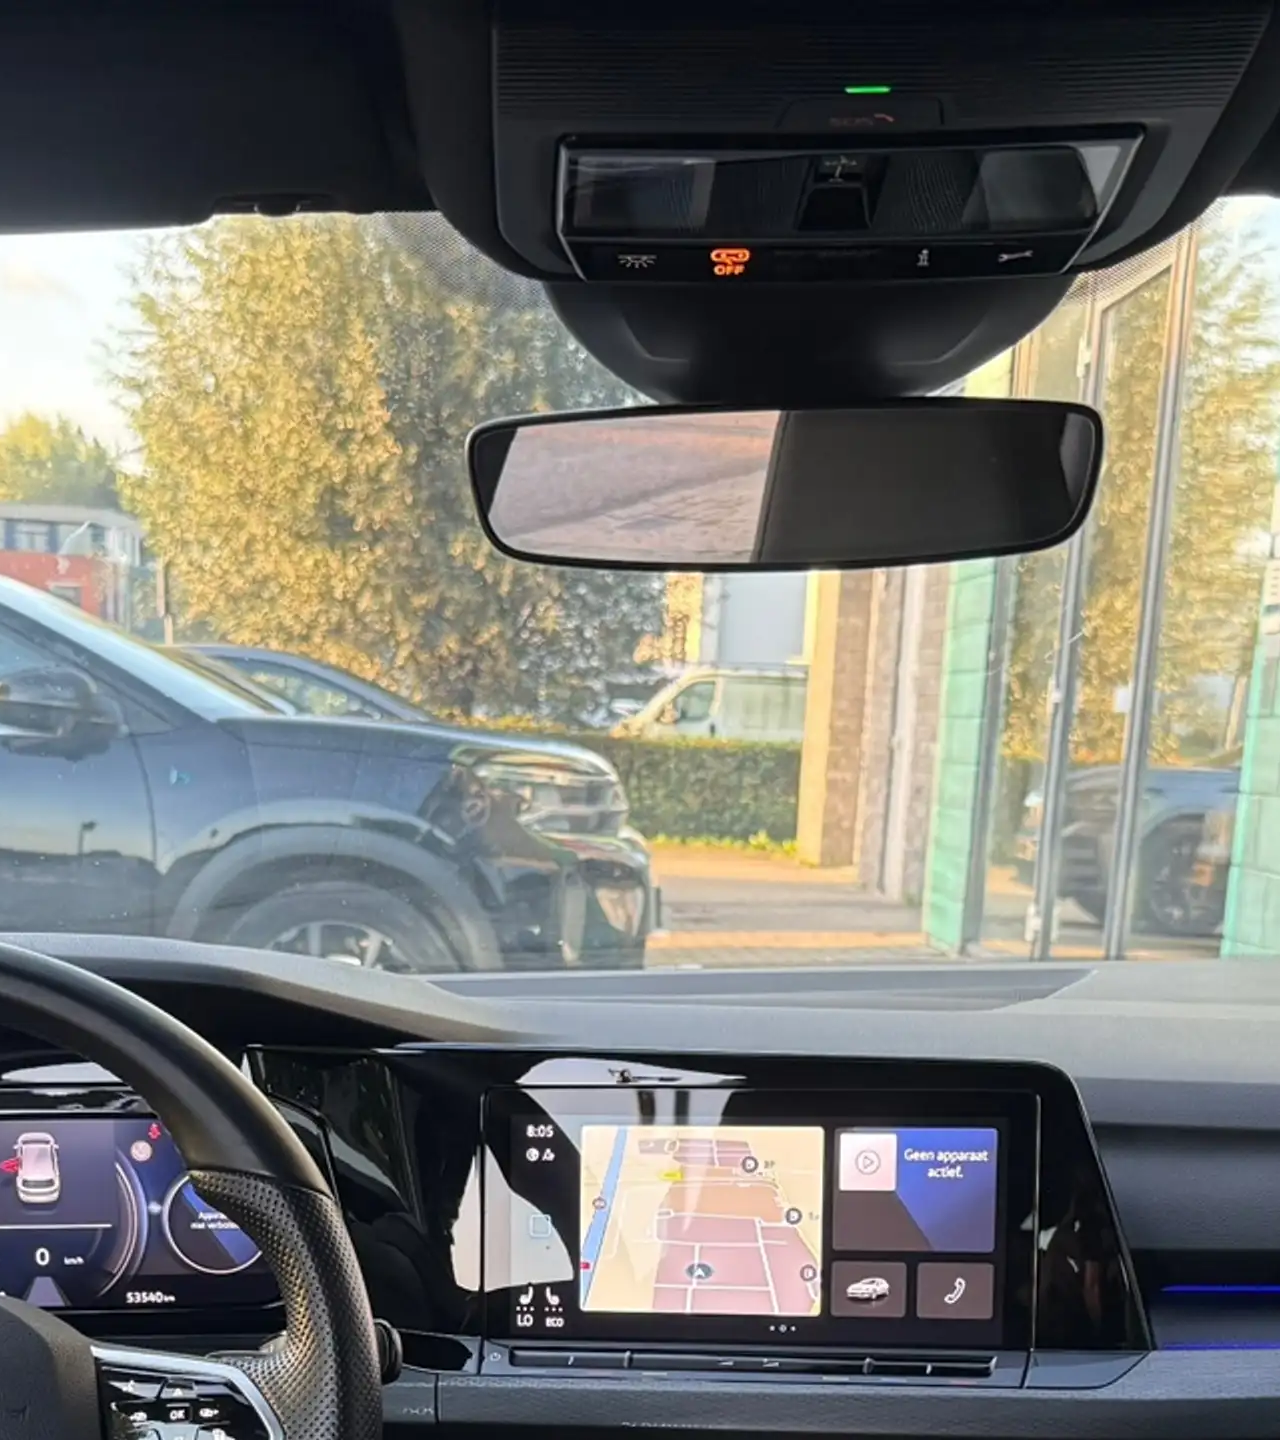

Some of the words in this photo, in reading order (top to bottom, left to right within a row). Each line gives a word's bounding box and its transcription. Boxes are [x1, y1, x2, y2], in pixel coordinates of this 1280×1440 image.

[713, 264, 745, 276] OFF
[526, 1124, 554, 1138] 8:05
[904, 1148, 935, 1161] Geen
[936, 1149, 989, 1163] apparaat
[35, 1247, 50, 1266] 0
[516, 1314, 534, 1328] LO
[545, 1317, 565, 1328] ECO
[169, 1409, 186, 1421] OK
